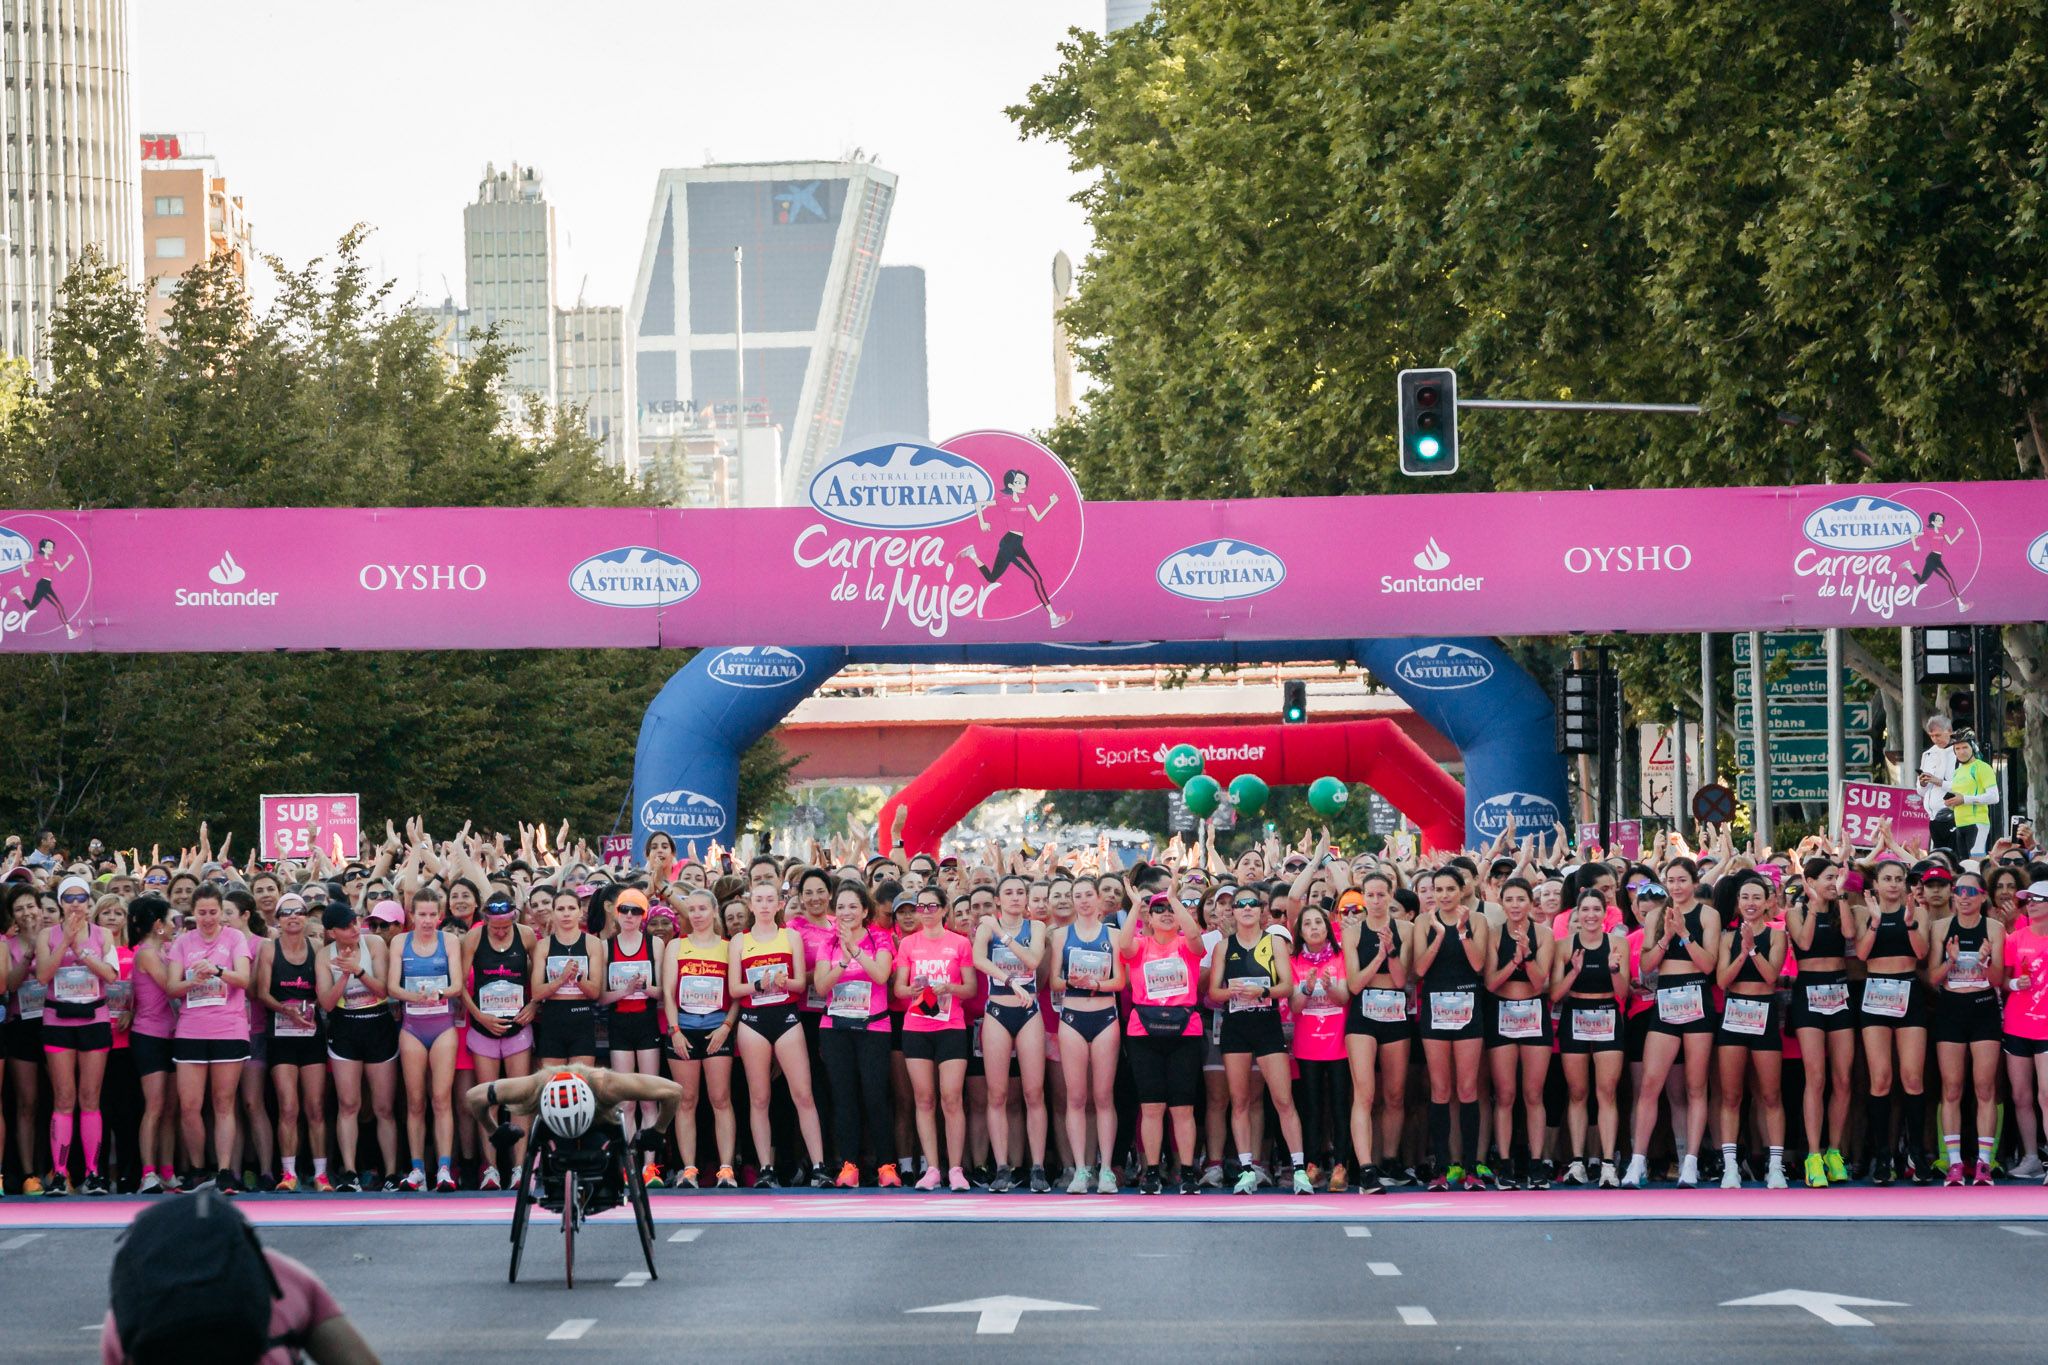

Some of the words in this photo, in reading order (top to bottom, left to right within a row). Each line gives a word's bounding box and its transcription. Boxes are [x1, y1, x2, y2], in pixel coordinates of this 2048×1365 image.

[649, 399, 698, 414] KERN
[850, 471, 911, 481] CENTRAL
[915, 471, 973, 480] LECHERA
[823, 475, 978, 507] ASTURIANA
[1813, 517, 1913, 538] ASTURIANA
[792, 523, 945, 568] Carrera
[1564, 544, 1692, 573] OYSHO
[1794, 548, 1892, 577] Carrera
[359, 564, 487, 591] OYSHO
[580, 569, 690, 592] ASTURIANA
[1168, 563, 1276, 586] ASTURIANA
[1381, 574, 1484, 594] Santander
[174, 588, 279, 607] Santander
[831, 570, 859, 602] de
[865, 569, 885, 601] la
[881, 563, 1003, 638] Mujer
[1818, 578, 1837, 597] de
[1840, 577, 1853, 597] la
[1851, 572, 1928, 619] Mujer
[713, 658, 797, 677] ASTURIANA
[1404, 661, 1487, 678] ASTURIANA
[1770, 707, 1783, 715] de
[1767, 718, 1806, 729] abana
[1095, 746, 1151, 767] Sports
[1769, 752, 1828, 763] Villaverd
[1741, 787, 1785, 798] Curo
[1788, 786, 1829, 798] Camin
[1781, 778, 1793, 786] de
[1847, 788, 1892, 810] SUB
[277, 803, 319, 822] SUB
[645, 807, 720, 827] ASTURIANA
[915, 960, 950, 975] HOY
